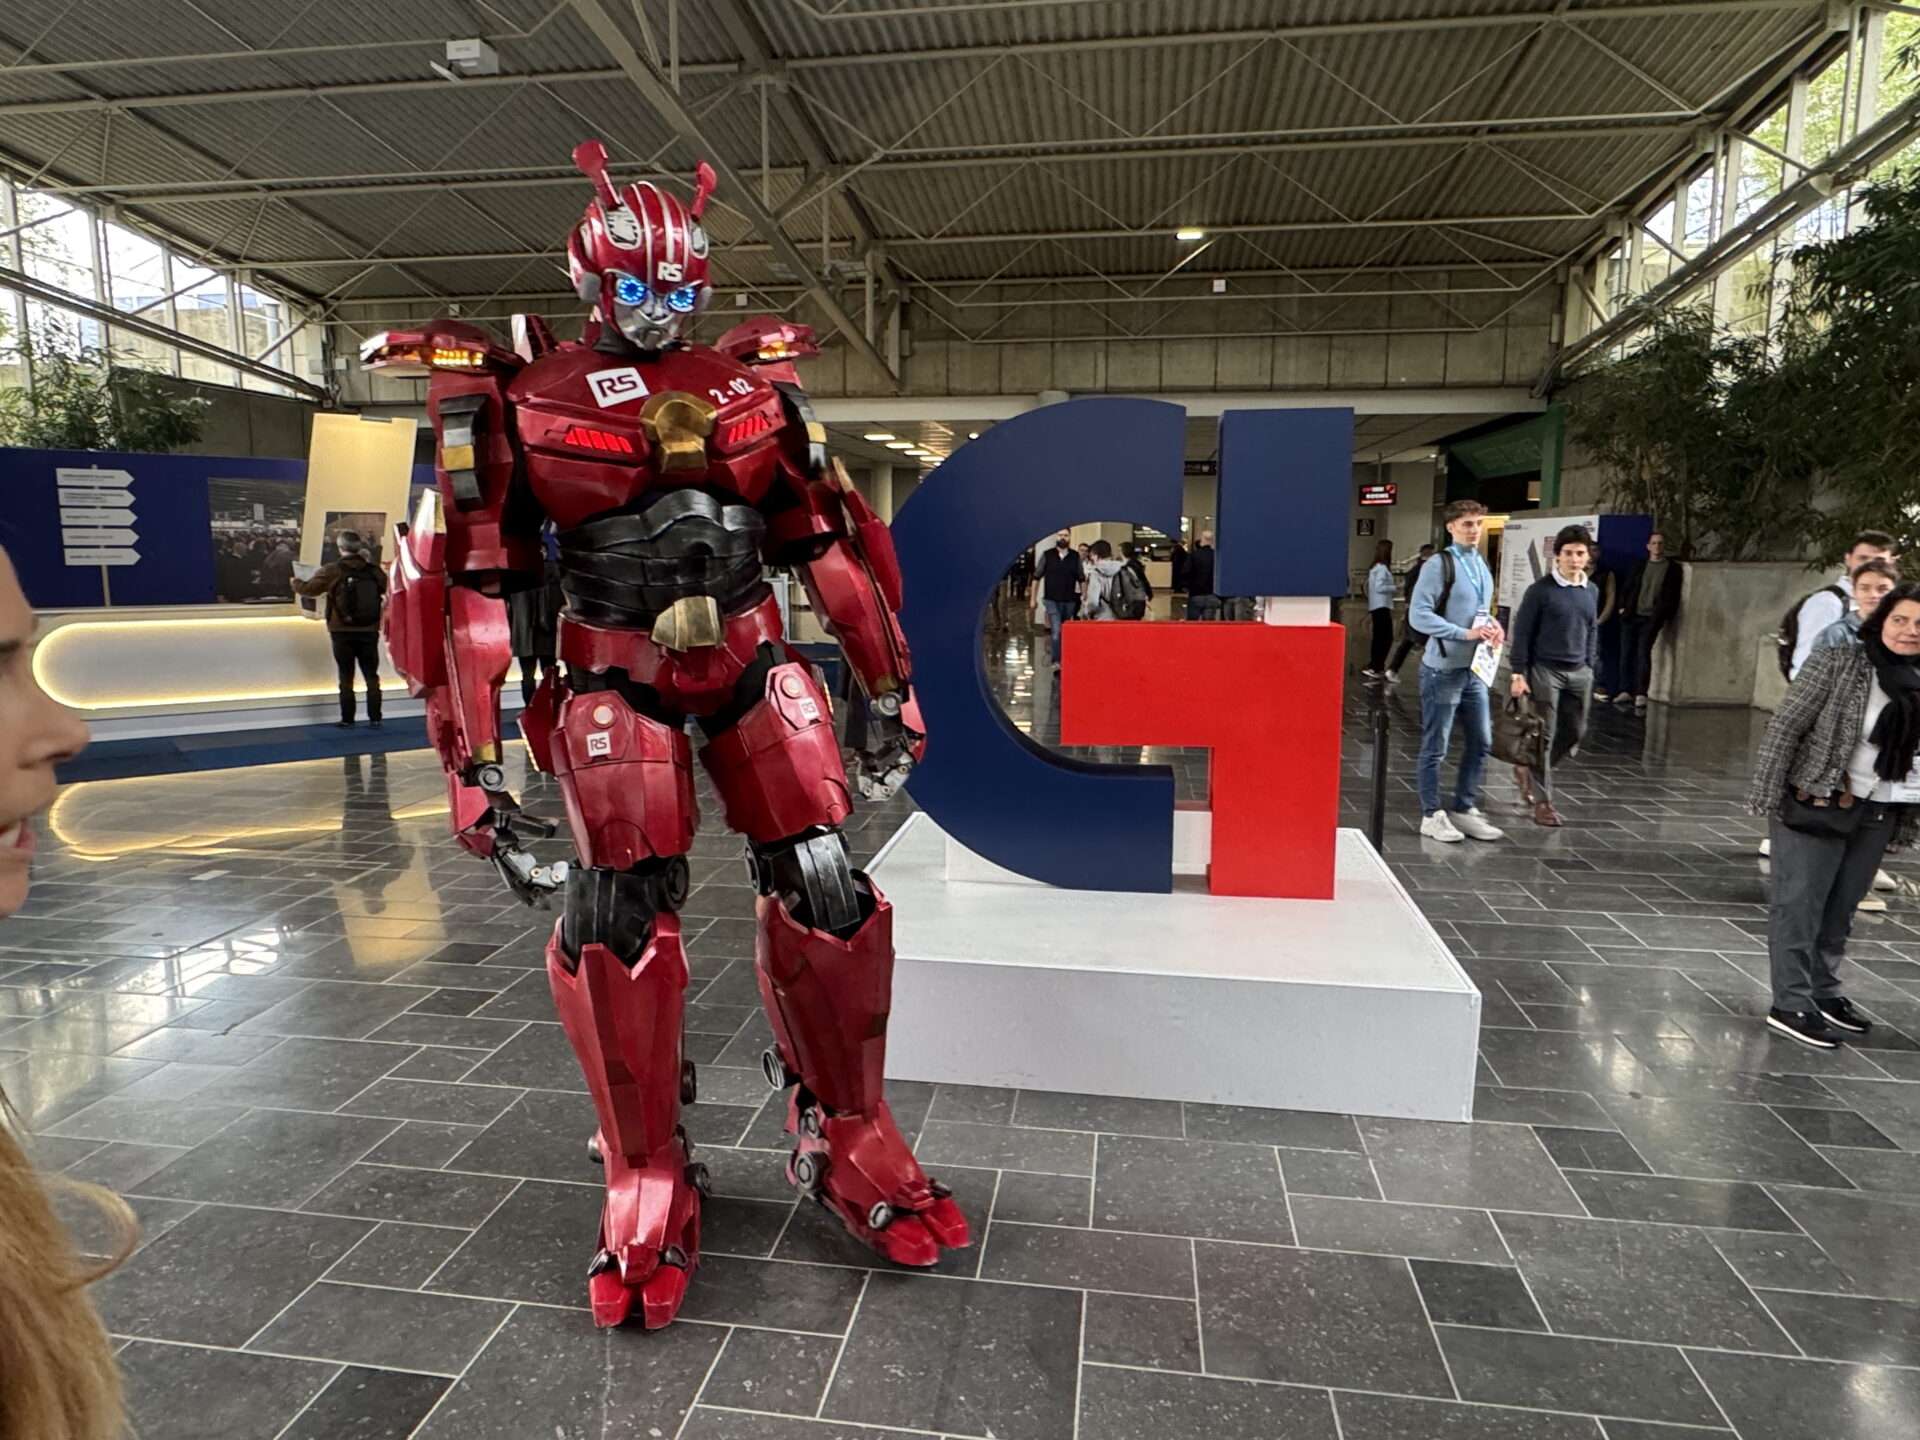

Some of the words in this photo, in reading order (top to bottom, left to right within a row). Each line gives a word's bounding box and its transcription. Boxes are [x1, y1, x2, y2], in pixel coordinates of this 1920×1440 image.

[657, 261, 682, 281] RS
[597, 374, 637, 398] RS
[708, 377, 755, 405] 2-02
[590, 736, 607, 751] RS
